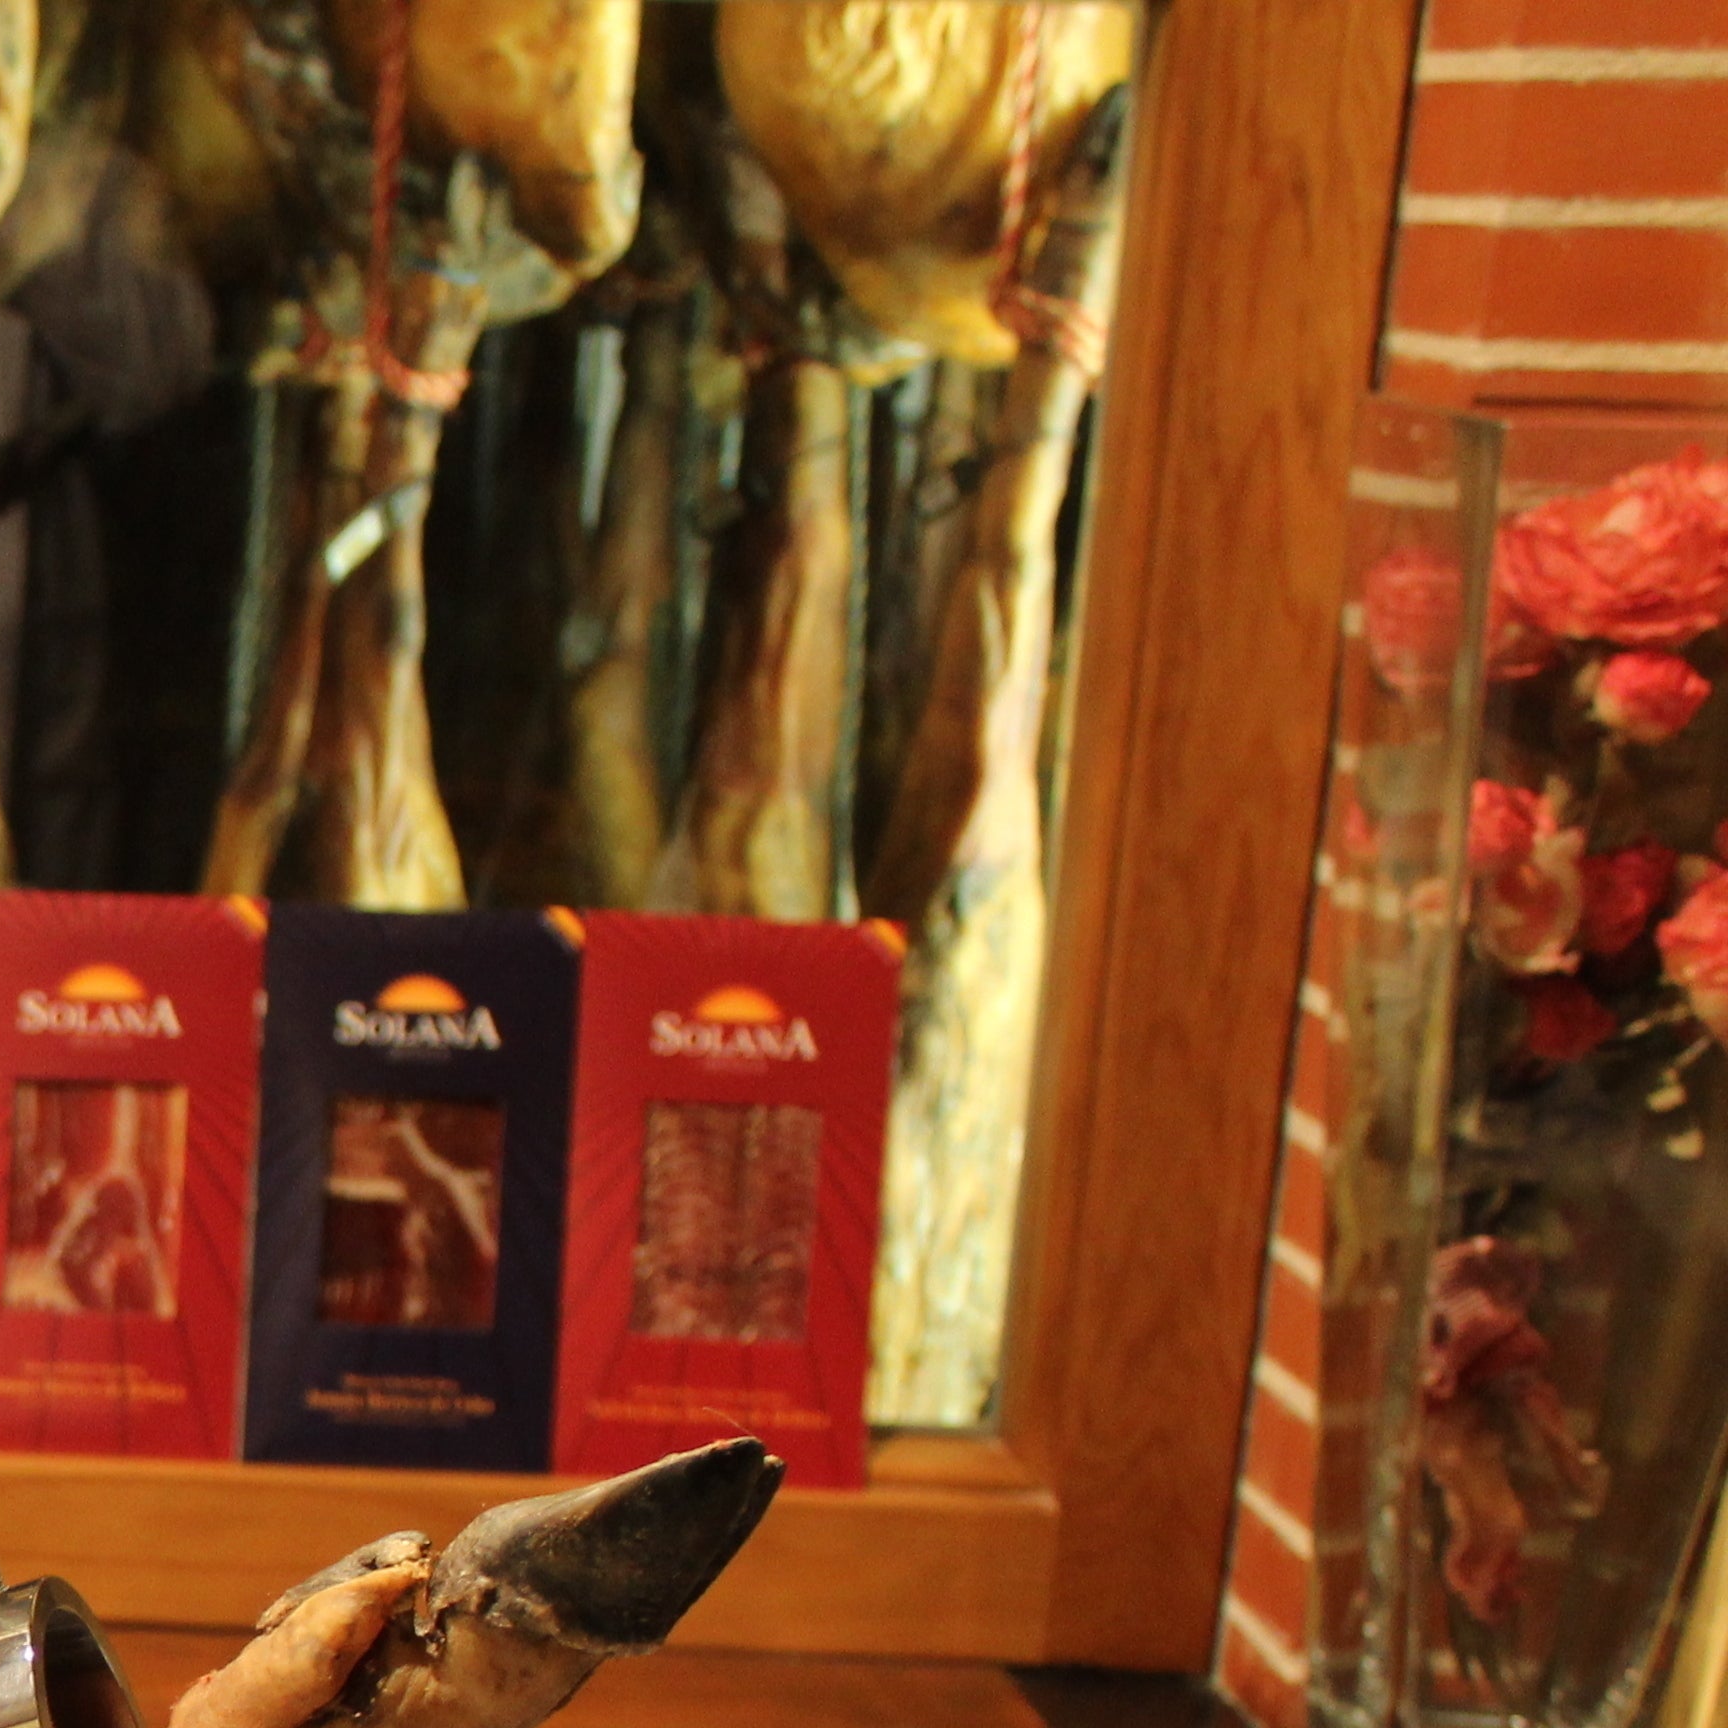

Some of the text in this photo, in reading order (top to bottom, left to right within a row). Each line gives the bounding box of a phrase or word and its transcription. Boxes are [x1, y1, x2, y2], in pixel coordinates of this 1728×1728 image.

[15, 989, 183, 1039] SOLANA
[333, 1000, 501, 1051] SOLANA
[649, 1011, 820, 1063] SOLANA
